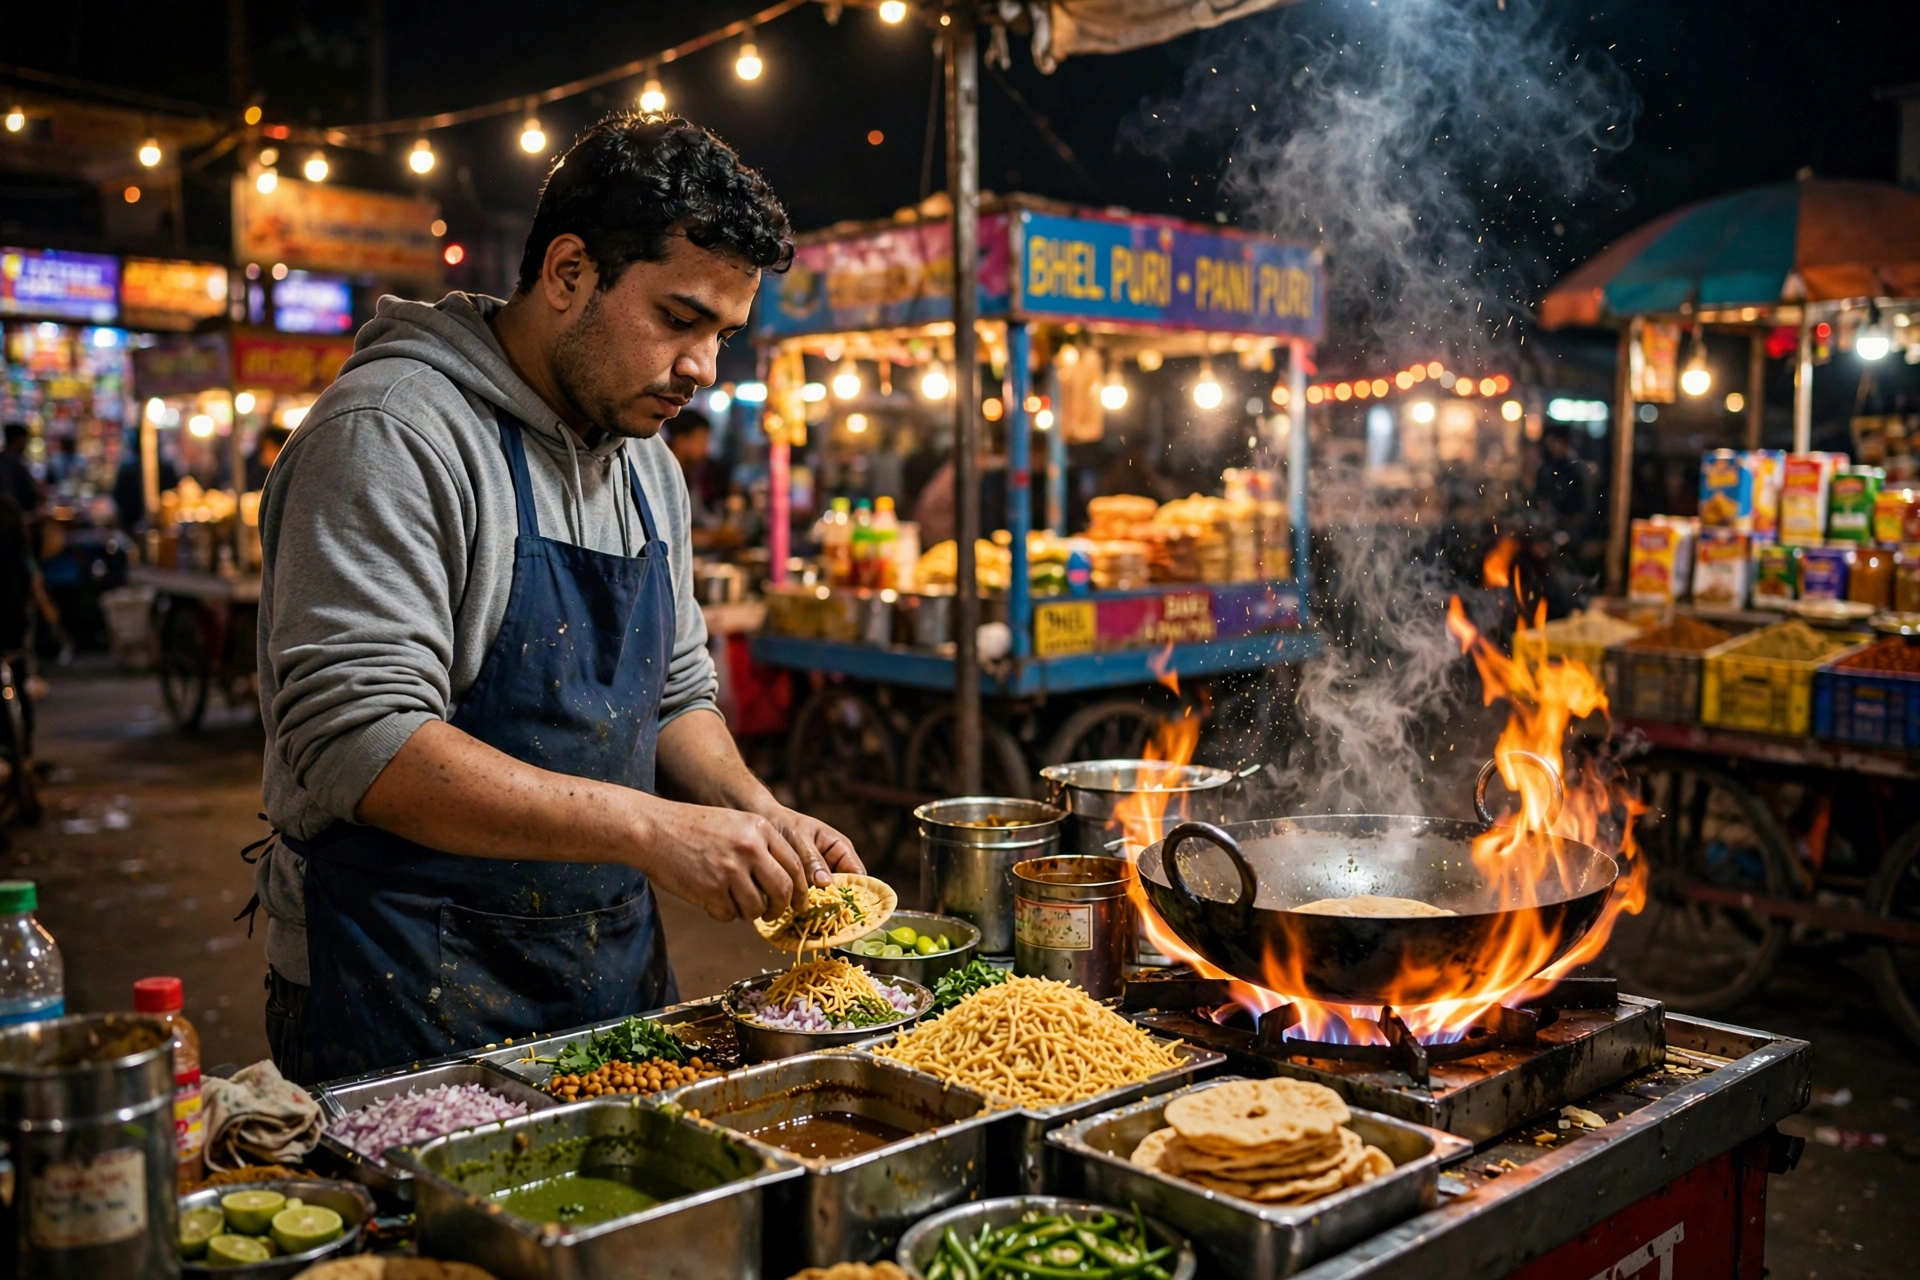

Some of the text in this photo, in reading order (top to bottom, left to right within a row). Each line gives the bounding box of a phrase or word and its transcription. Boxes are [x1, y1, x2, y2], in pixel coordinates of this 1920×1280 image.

[1028, 235, 1314, 320] BHEL PURI PANI PURI
